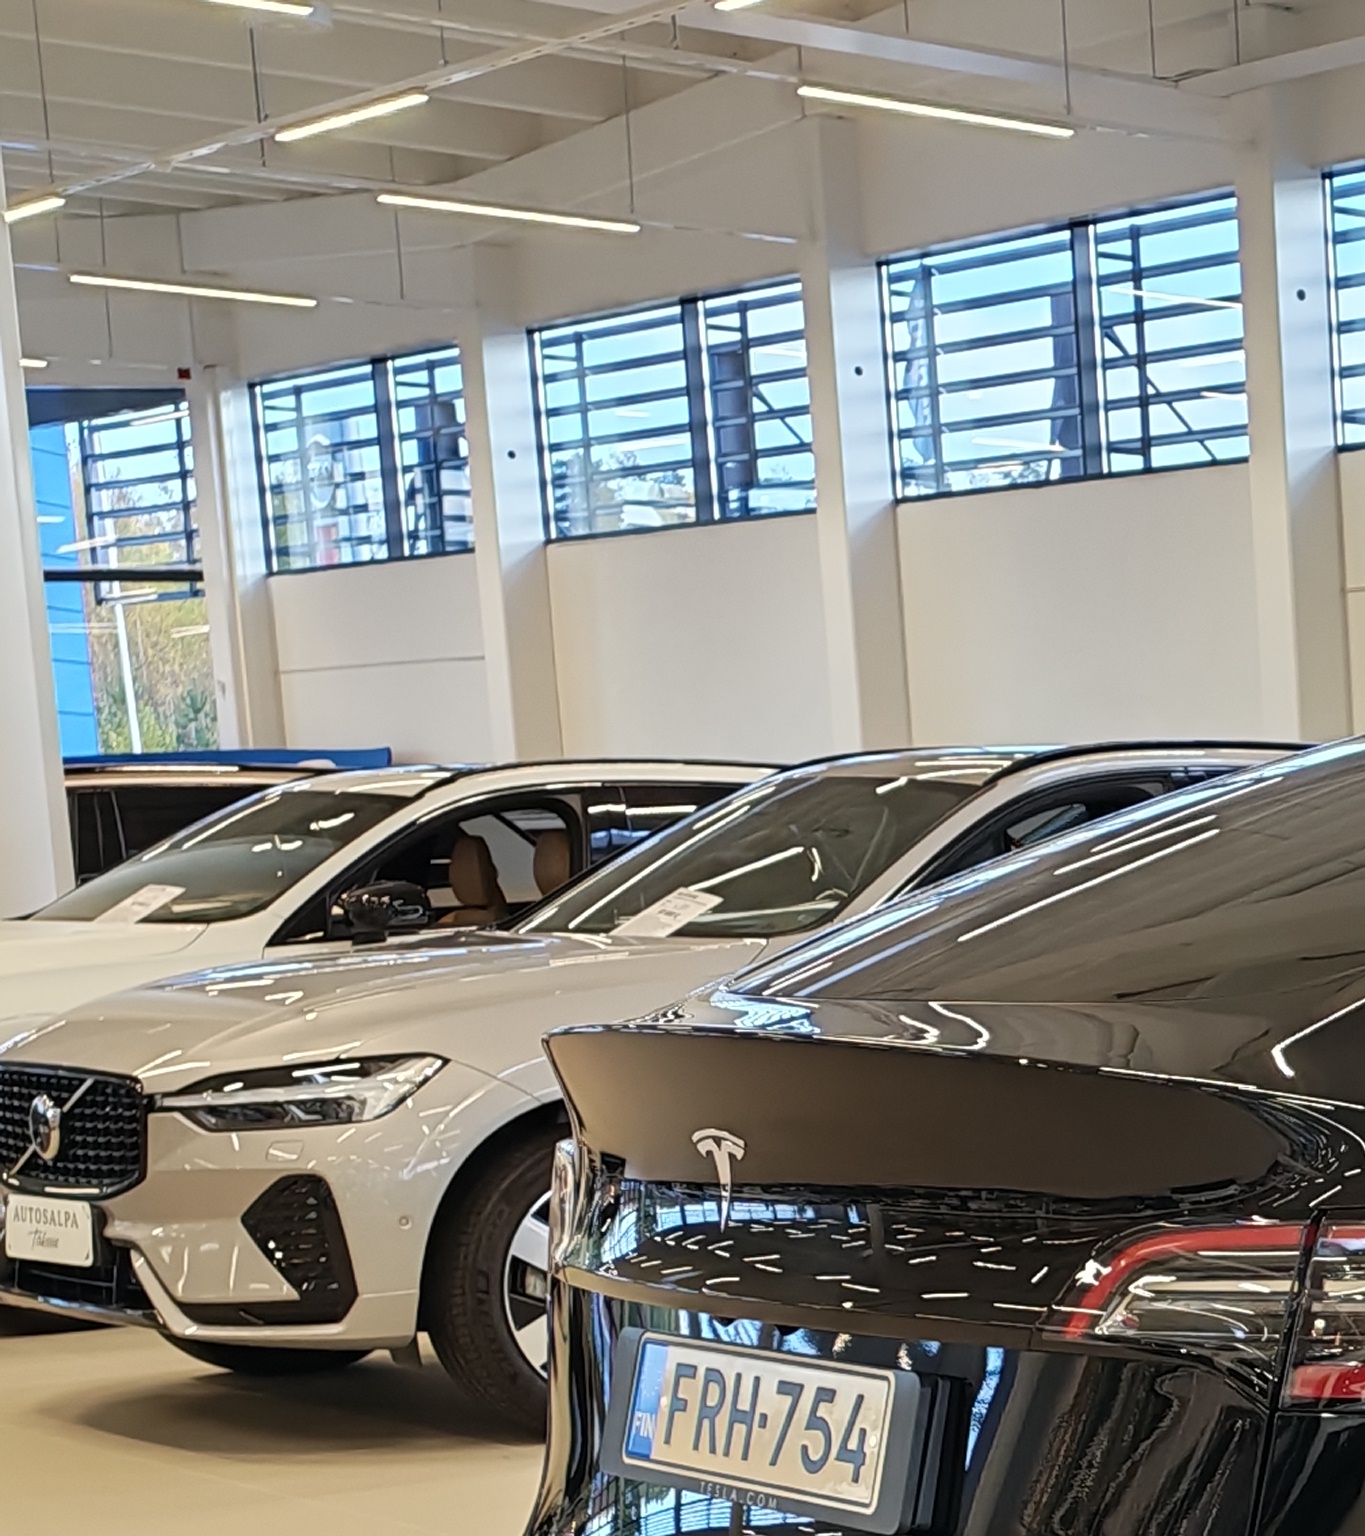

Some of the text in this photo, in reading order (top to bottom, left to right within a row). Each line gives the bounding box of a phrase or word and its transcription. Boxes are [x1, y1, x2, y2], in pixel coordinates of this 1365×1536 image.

[13, 1205, 79, 1229] AUTOSALPA
[634, 1410, 658, 1439] FIN
[663, 1362, 867, 1485] FRH-754
[699, 1480, 779, 1510] TESLA.COM
